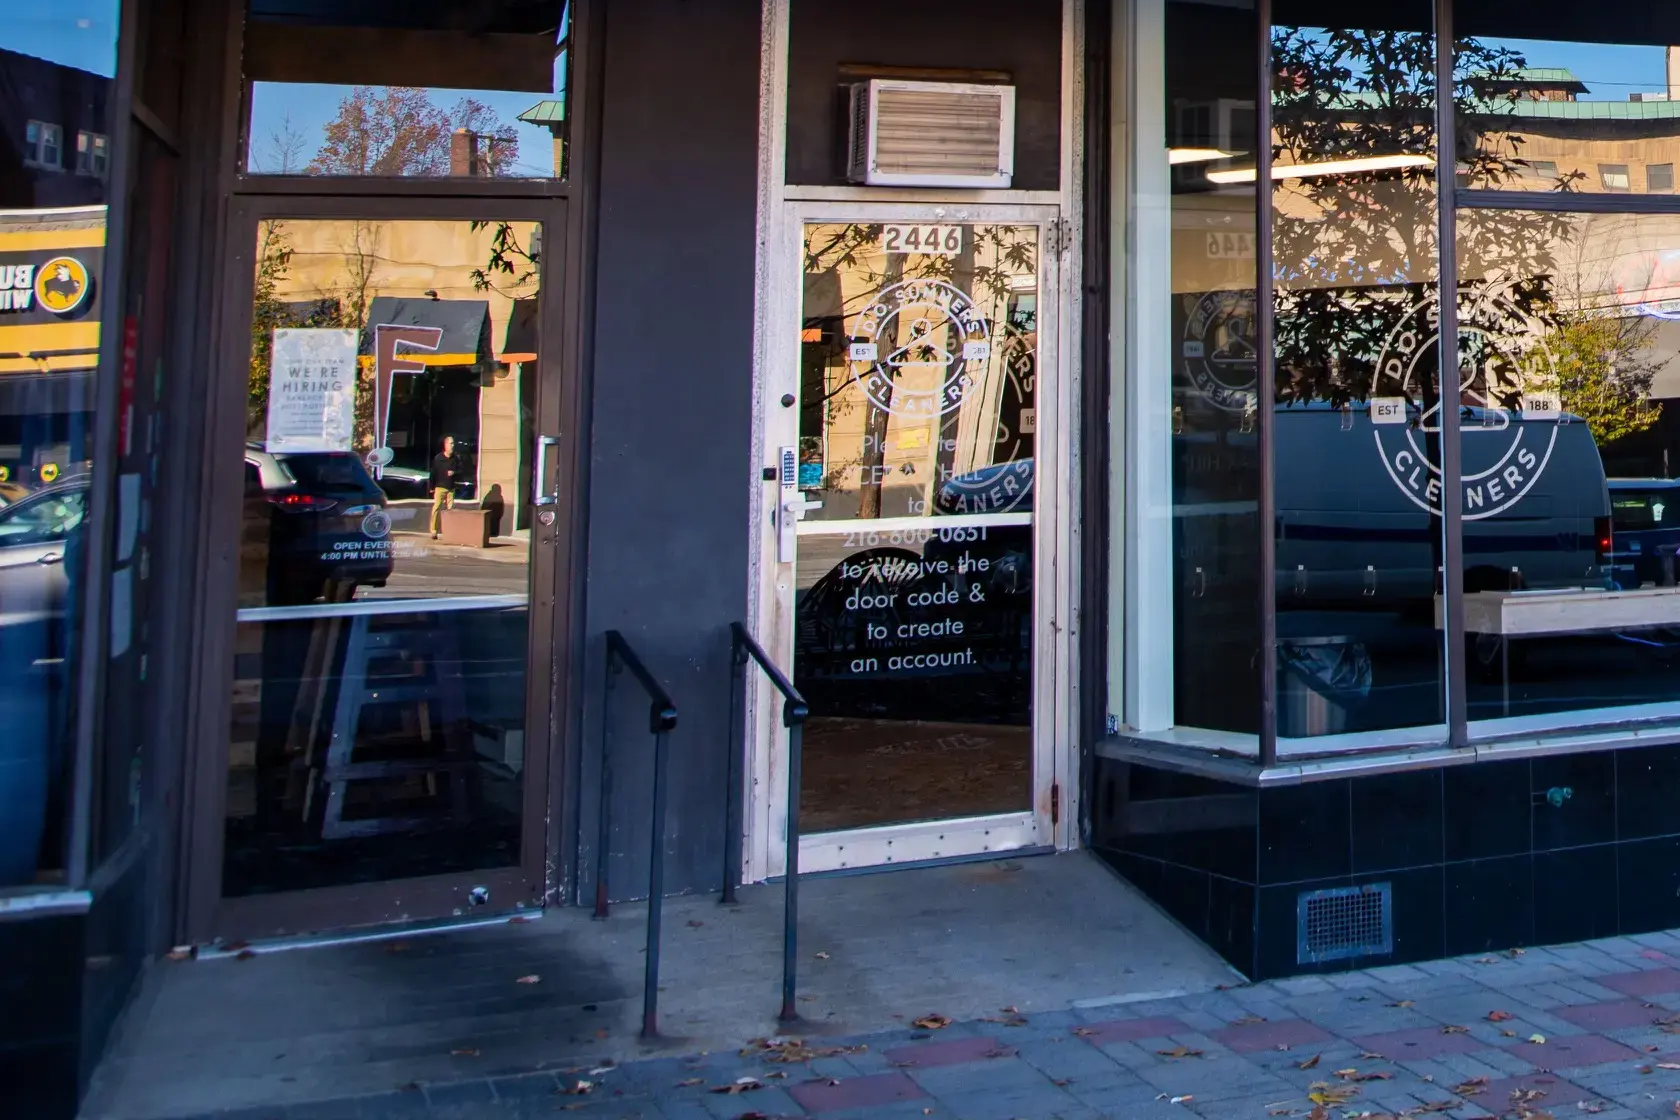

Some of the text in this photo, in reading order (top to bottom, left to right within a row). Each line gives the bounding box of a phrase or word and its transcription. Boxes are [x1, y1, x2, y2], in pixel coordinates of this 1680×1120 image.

[886, 226, 960, 251] 2446
[863, 286, 980, 333] D.O. SUMMERS
[1385, 330, 1423, 380] D.O.
[289, 367, 339, 378] WE'RE
[282, 381, 343, 393] HIRING
[868, 375, 974, 412] CLEANERS
[1378, 404, 1399, 416] EST
[1529, 400, 1553, 412] 188
[940, 459, 1031, 514] EANERS
[1395, 447, 1537, 509] CLENERS
[320, 552, 341, 560] 4:00
[343, 551, 358, 560] PM
[360, 550, 389, 559] UNTIL
[333, 541, 361, 550] OPEN
[842, 550, 990, 579] to receive the
[845, 582, 986, 610] door code &
[867, 618, 964, 640] to create
[850, 647, 977, 672] an account.
